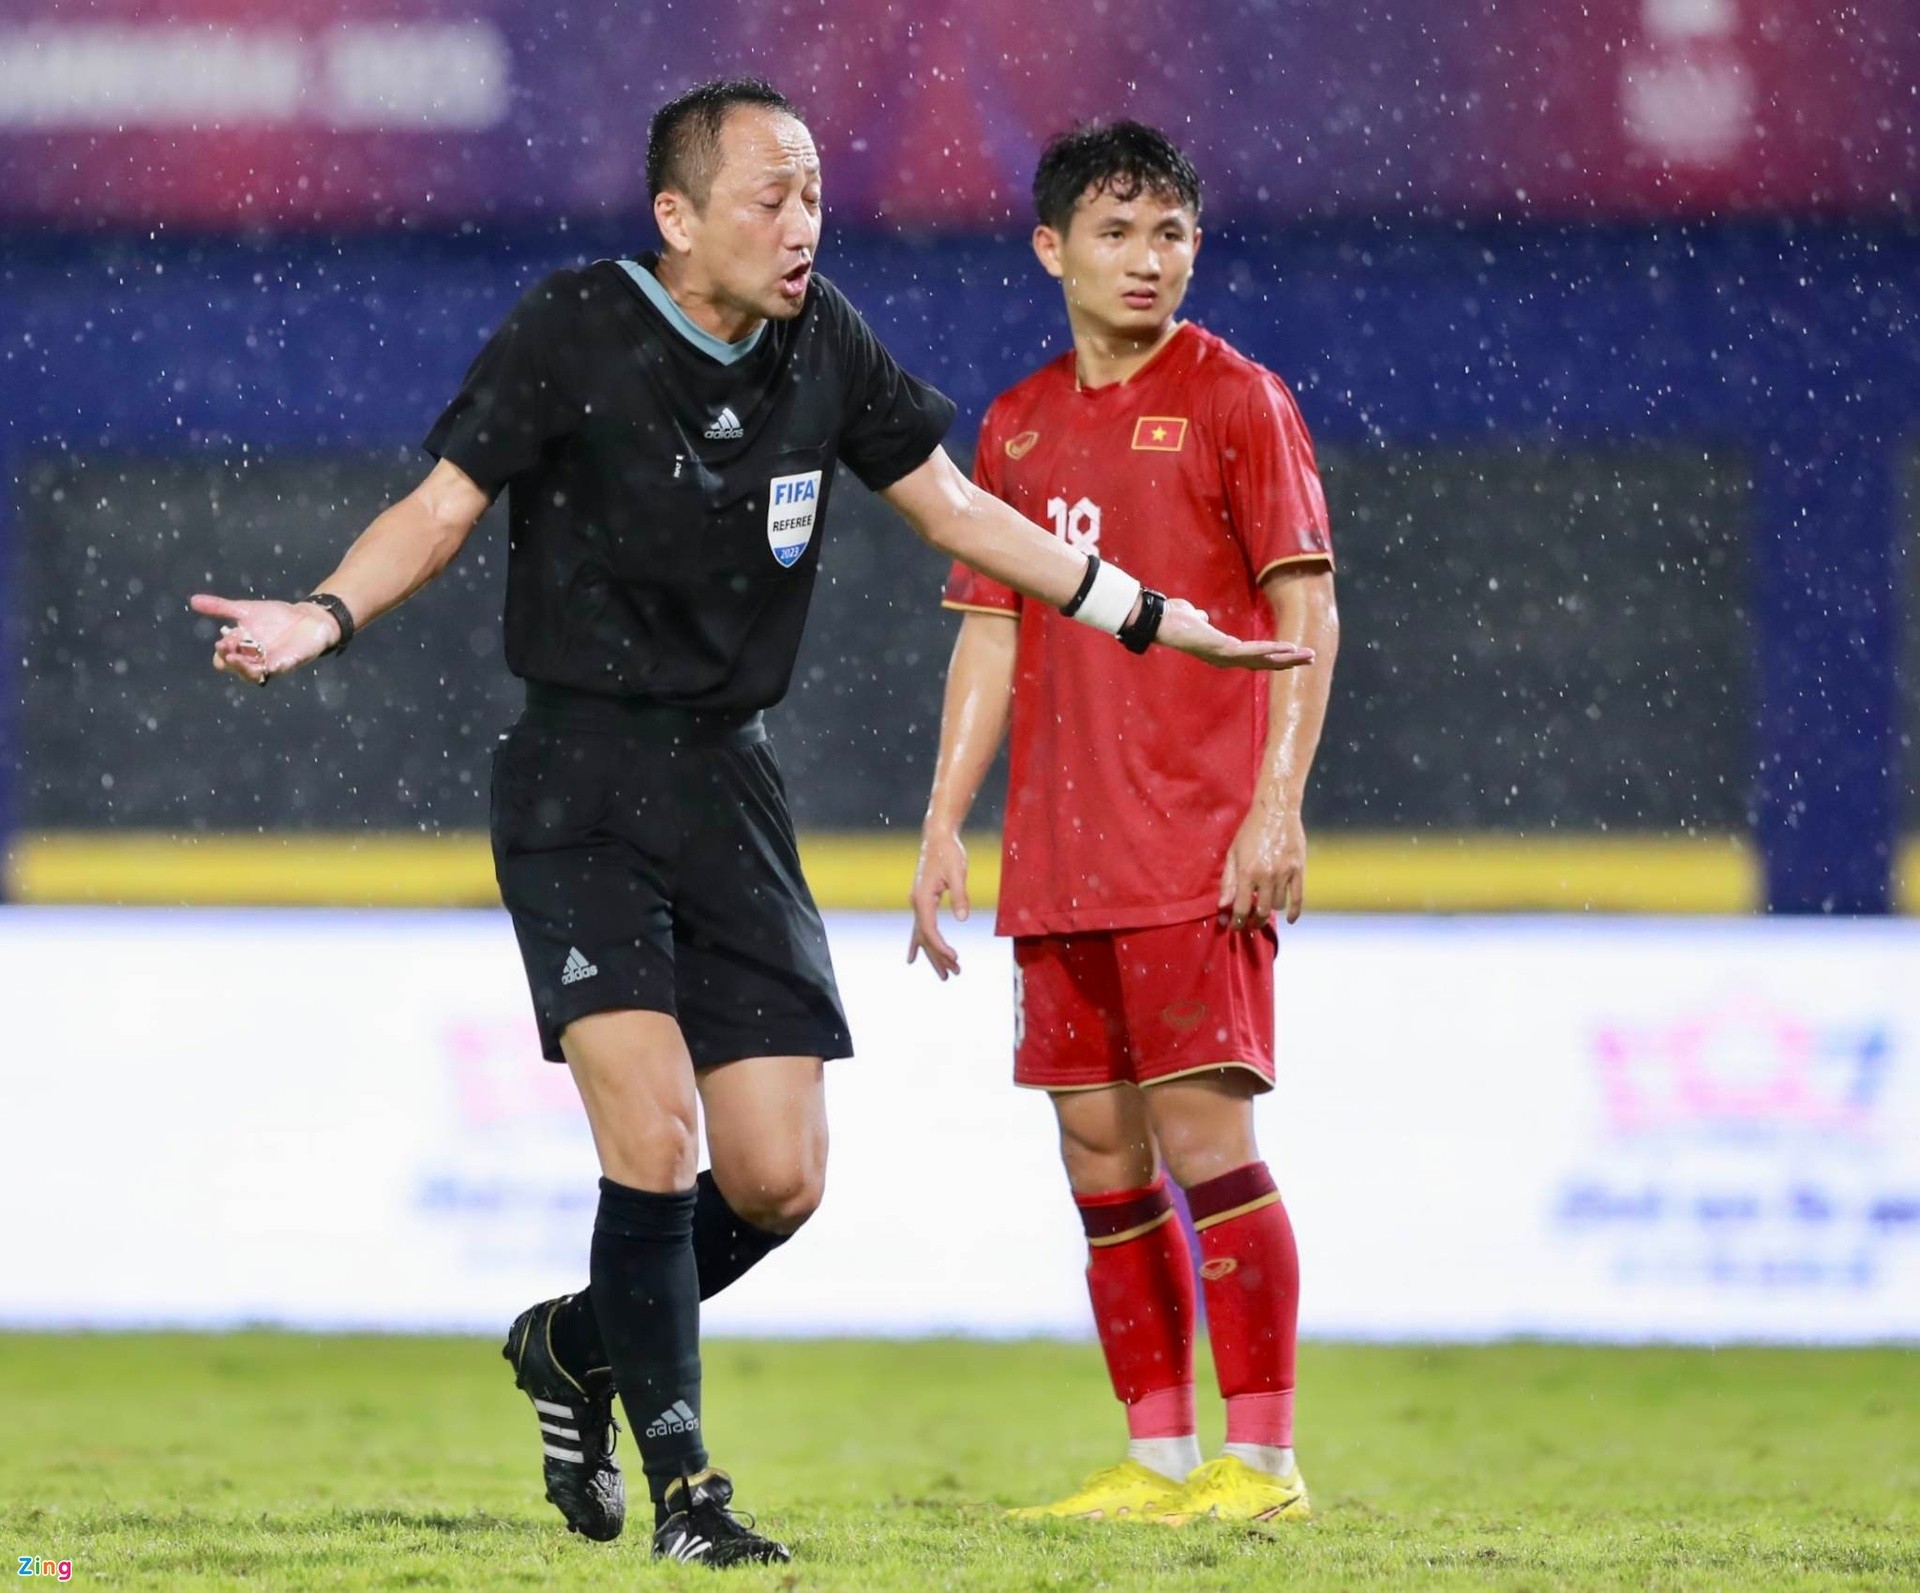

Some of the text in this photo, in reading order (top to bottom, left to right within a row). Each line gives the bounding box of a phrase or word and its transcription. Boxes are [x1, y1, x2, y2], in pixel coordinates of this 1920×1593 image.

[704, 427, 744, 439] adidas
[775, 479, 815, 506] FIFA
[773, 514, 813, 532] REFEREE
[780, 546, 800, 560] 2023
[561, 965, 598, 985] adidas
[646, 1417, 699, 1438] adidas
